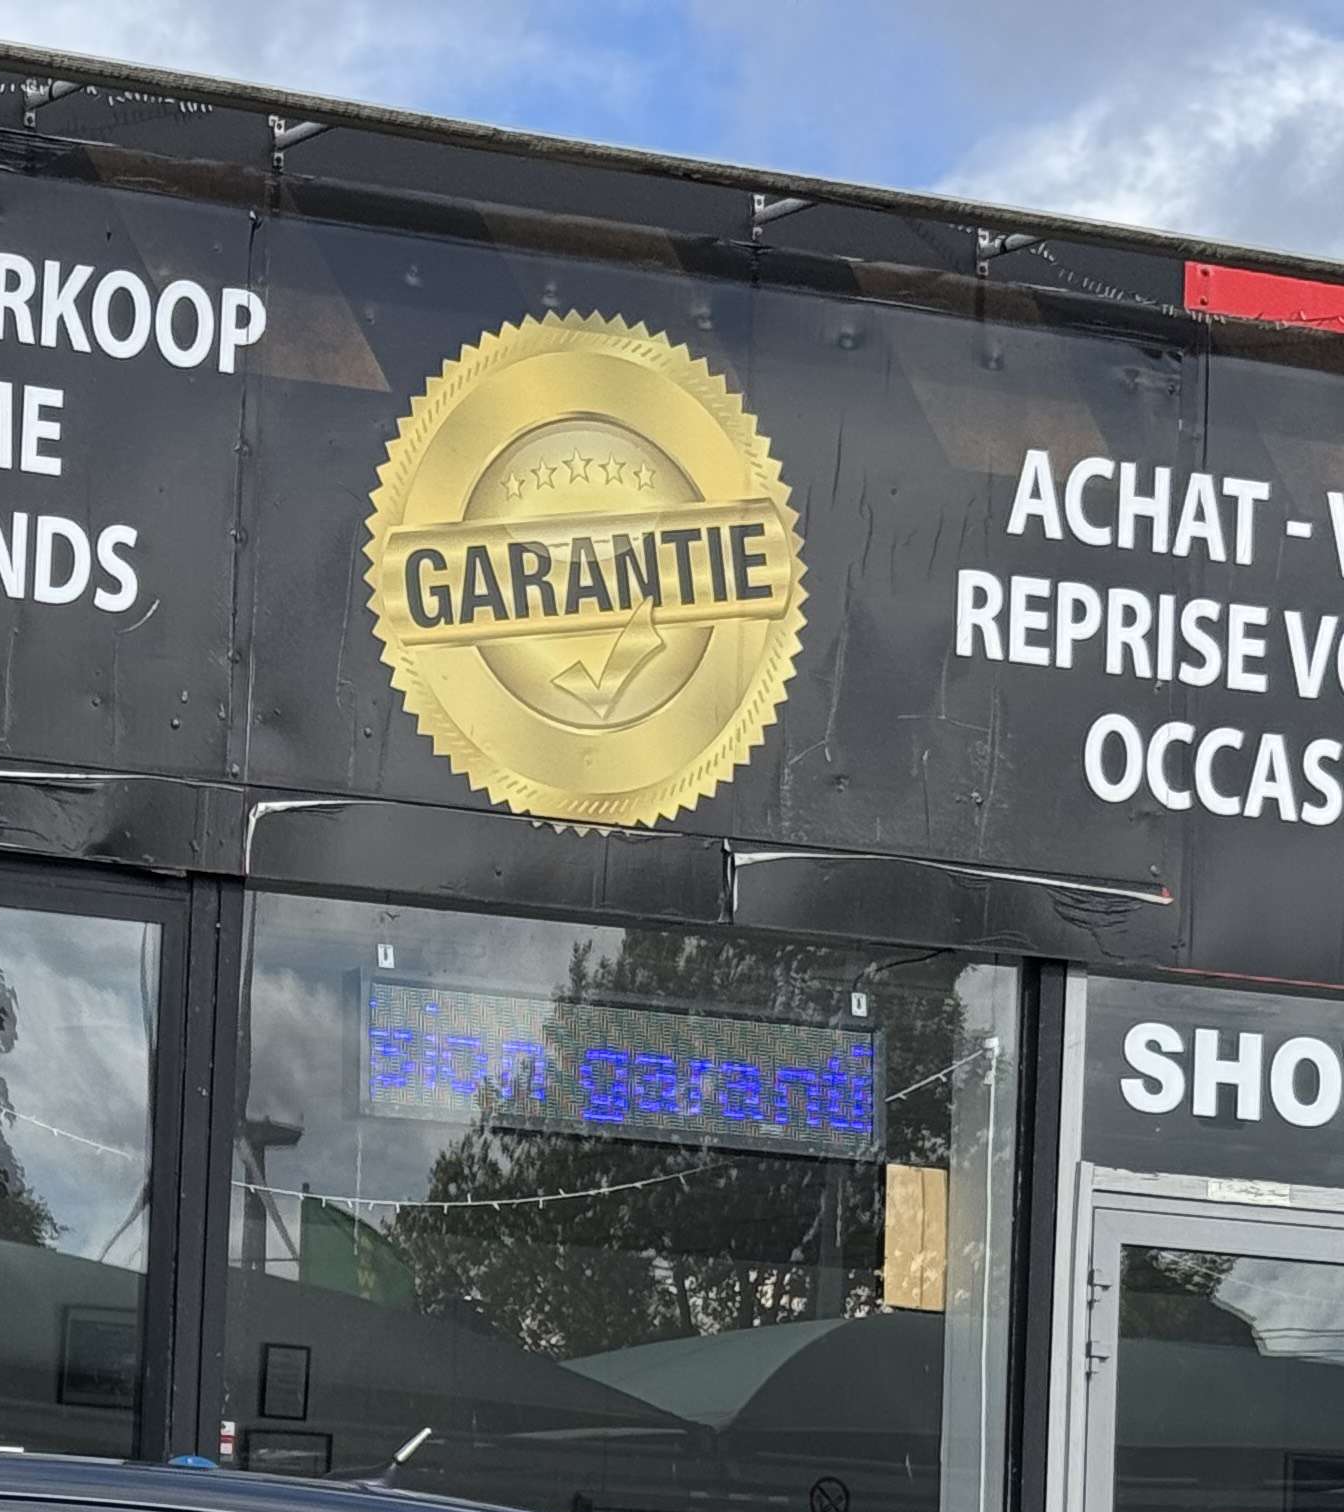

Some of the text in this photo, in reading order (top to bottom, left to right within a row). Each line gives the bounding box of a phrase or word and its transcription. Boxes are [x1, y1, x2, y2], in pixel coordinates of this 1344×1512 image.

[1006, 449, 1270, 566] ACHAT
[404, 522, 773, 631] GARANTIE
[955, 569, 1269, 693] REPRISE
[1084, 713, 1343, 826] OCCAS
[1120, 1021, 1343, 1128] SHO
